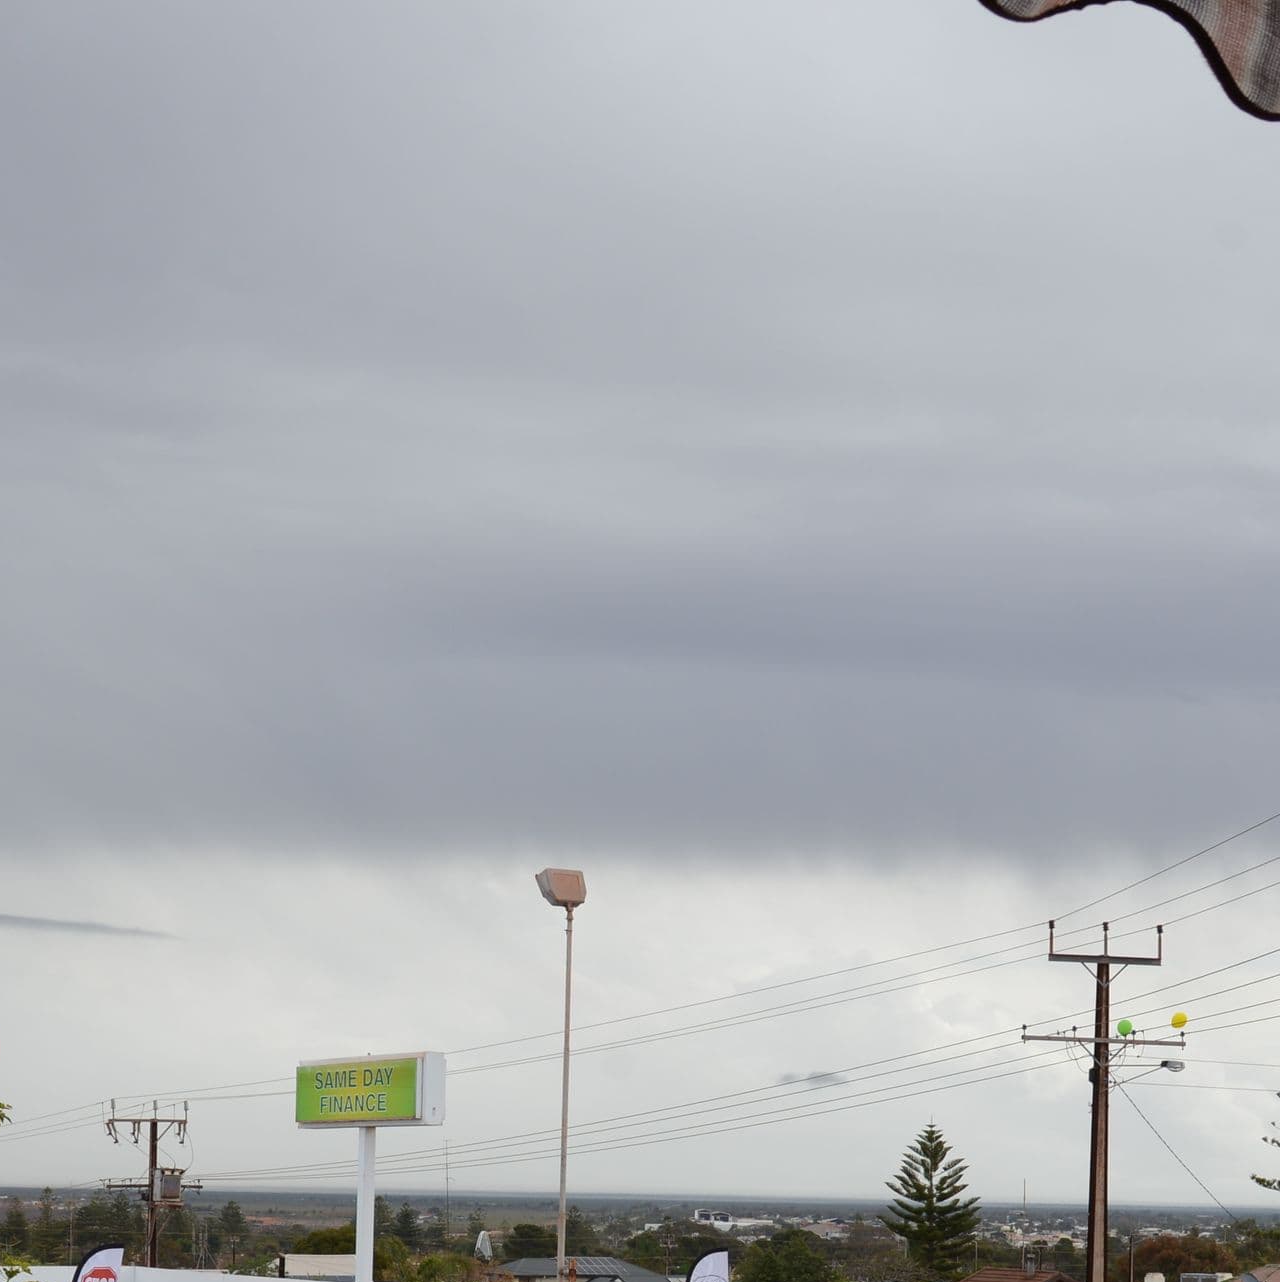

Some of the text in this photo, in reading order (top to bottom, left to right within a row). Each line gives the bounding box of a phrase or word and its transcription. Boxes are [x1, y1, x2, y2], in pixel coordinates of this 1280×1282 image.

[315, 1067, 393, 1090] SAME DAY
[320, 1093, 387, 1113] FINANCE
